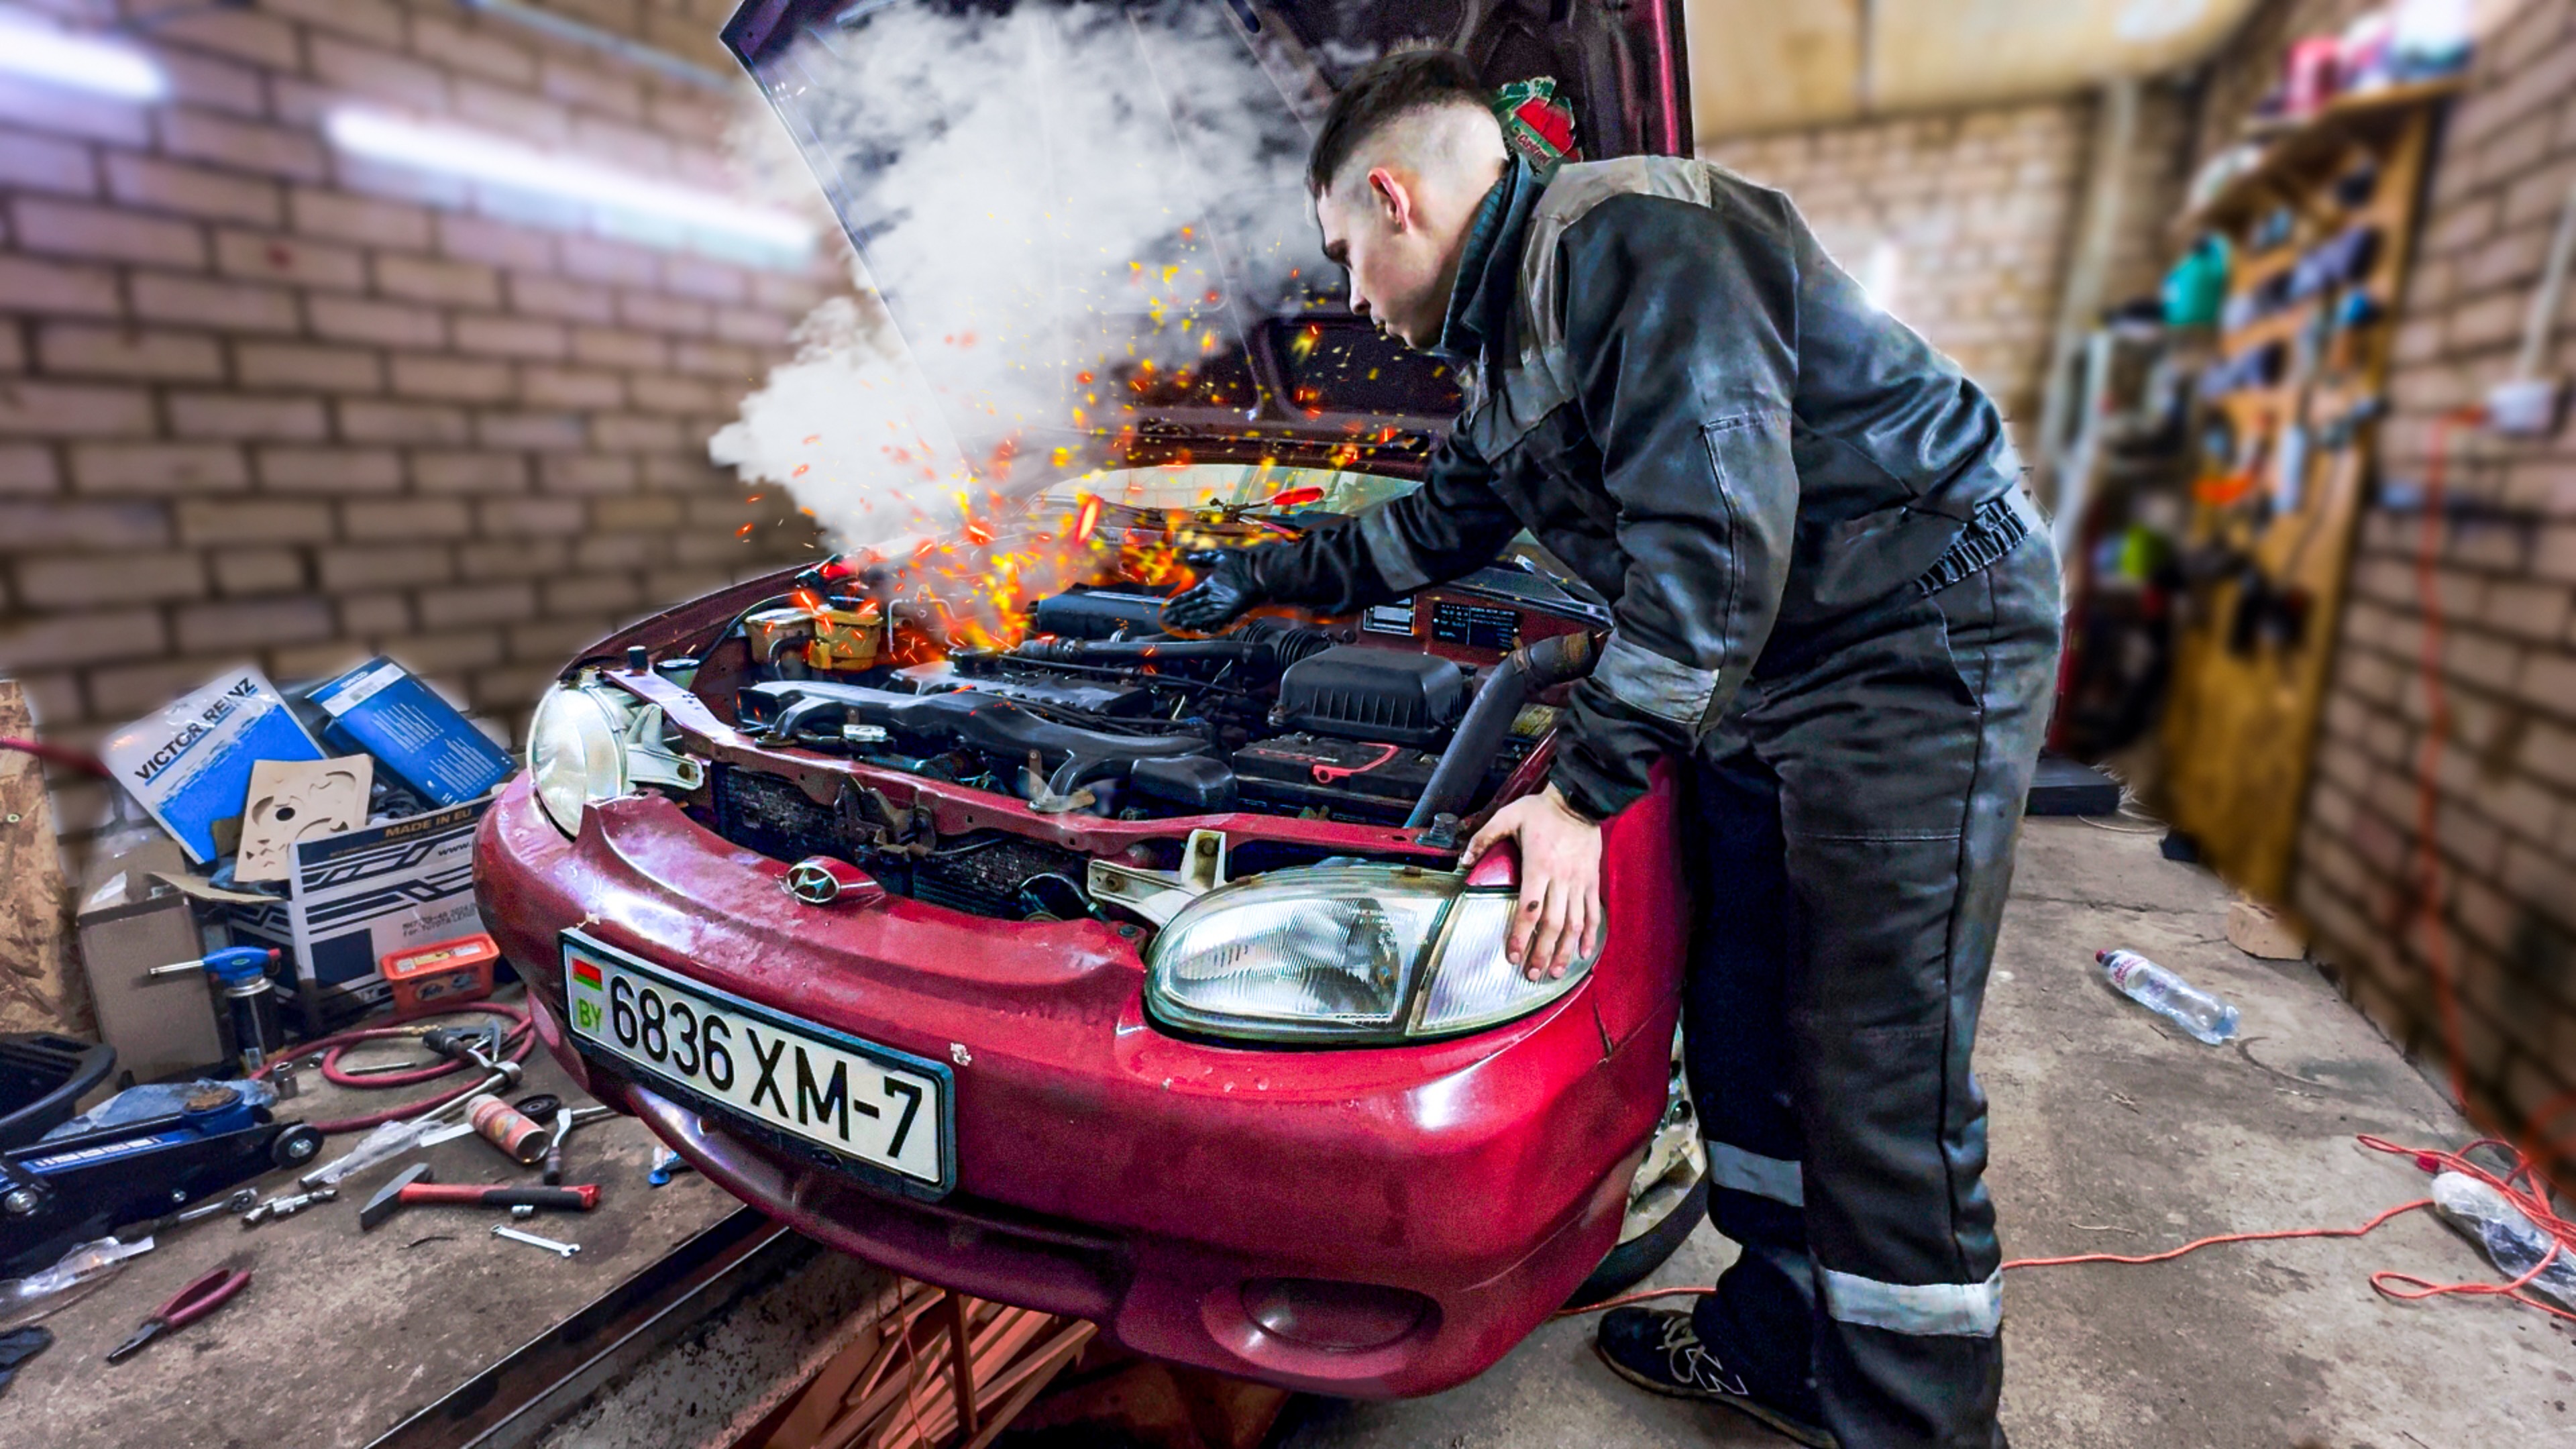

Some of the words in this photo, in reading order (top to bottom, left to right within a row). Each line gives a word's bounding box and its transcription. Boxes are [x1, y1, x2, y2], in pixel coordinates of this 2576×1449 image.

[134, 722, 203, 780] VICTOR
[385, 819, 432, 838] MADE
[436, 814, 450, 826] IN
[454, 808, 472, 820] EU
[578, 998, 602, 1032] BY
[610, 974, 735, 1091] 6836
[746, 1027, 922, 1159] XM-7
